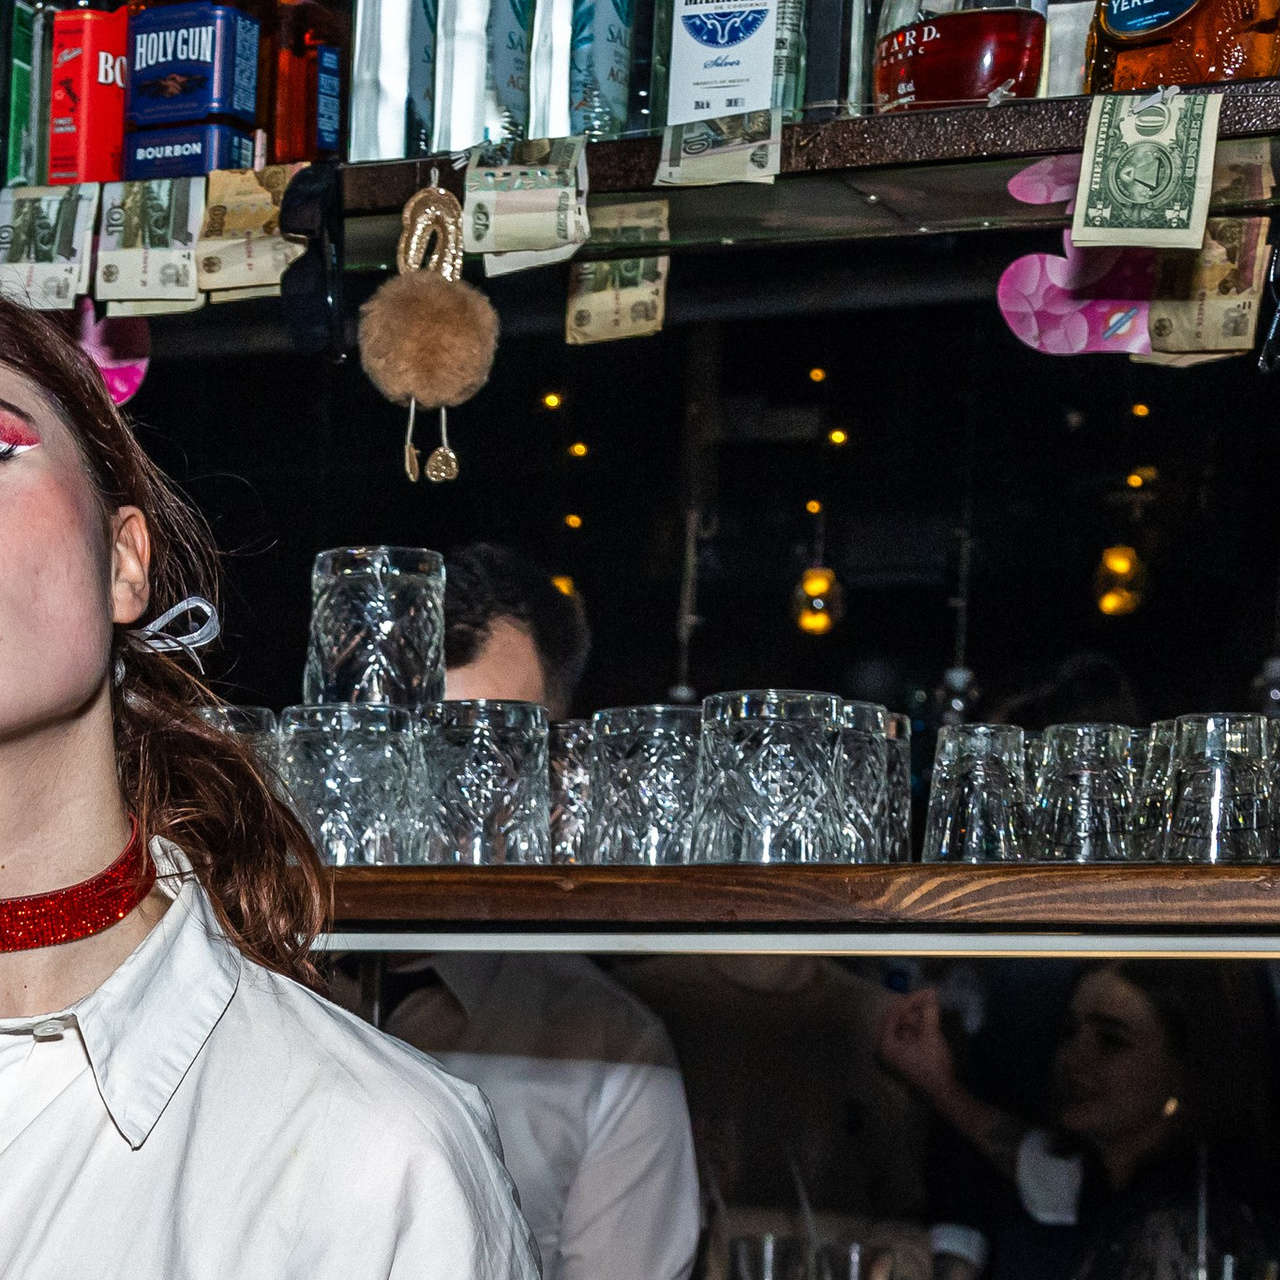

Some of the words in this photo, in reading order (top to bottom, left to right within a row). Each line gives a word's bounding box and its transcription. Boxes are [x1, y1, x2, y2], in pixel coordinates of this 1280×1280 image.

[134, 30, 176, 71] HOLY
[177, 26, 214, 63] GUN
[136, 142, 202, 160] BOURBON
